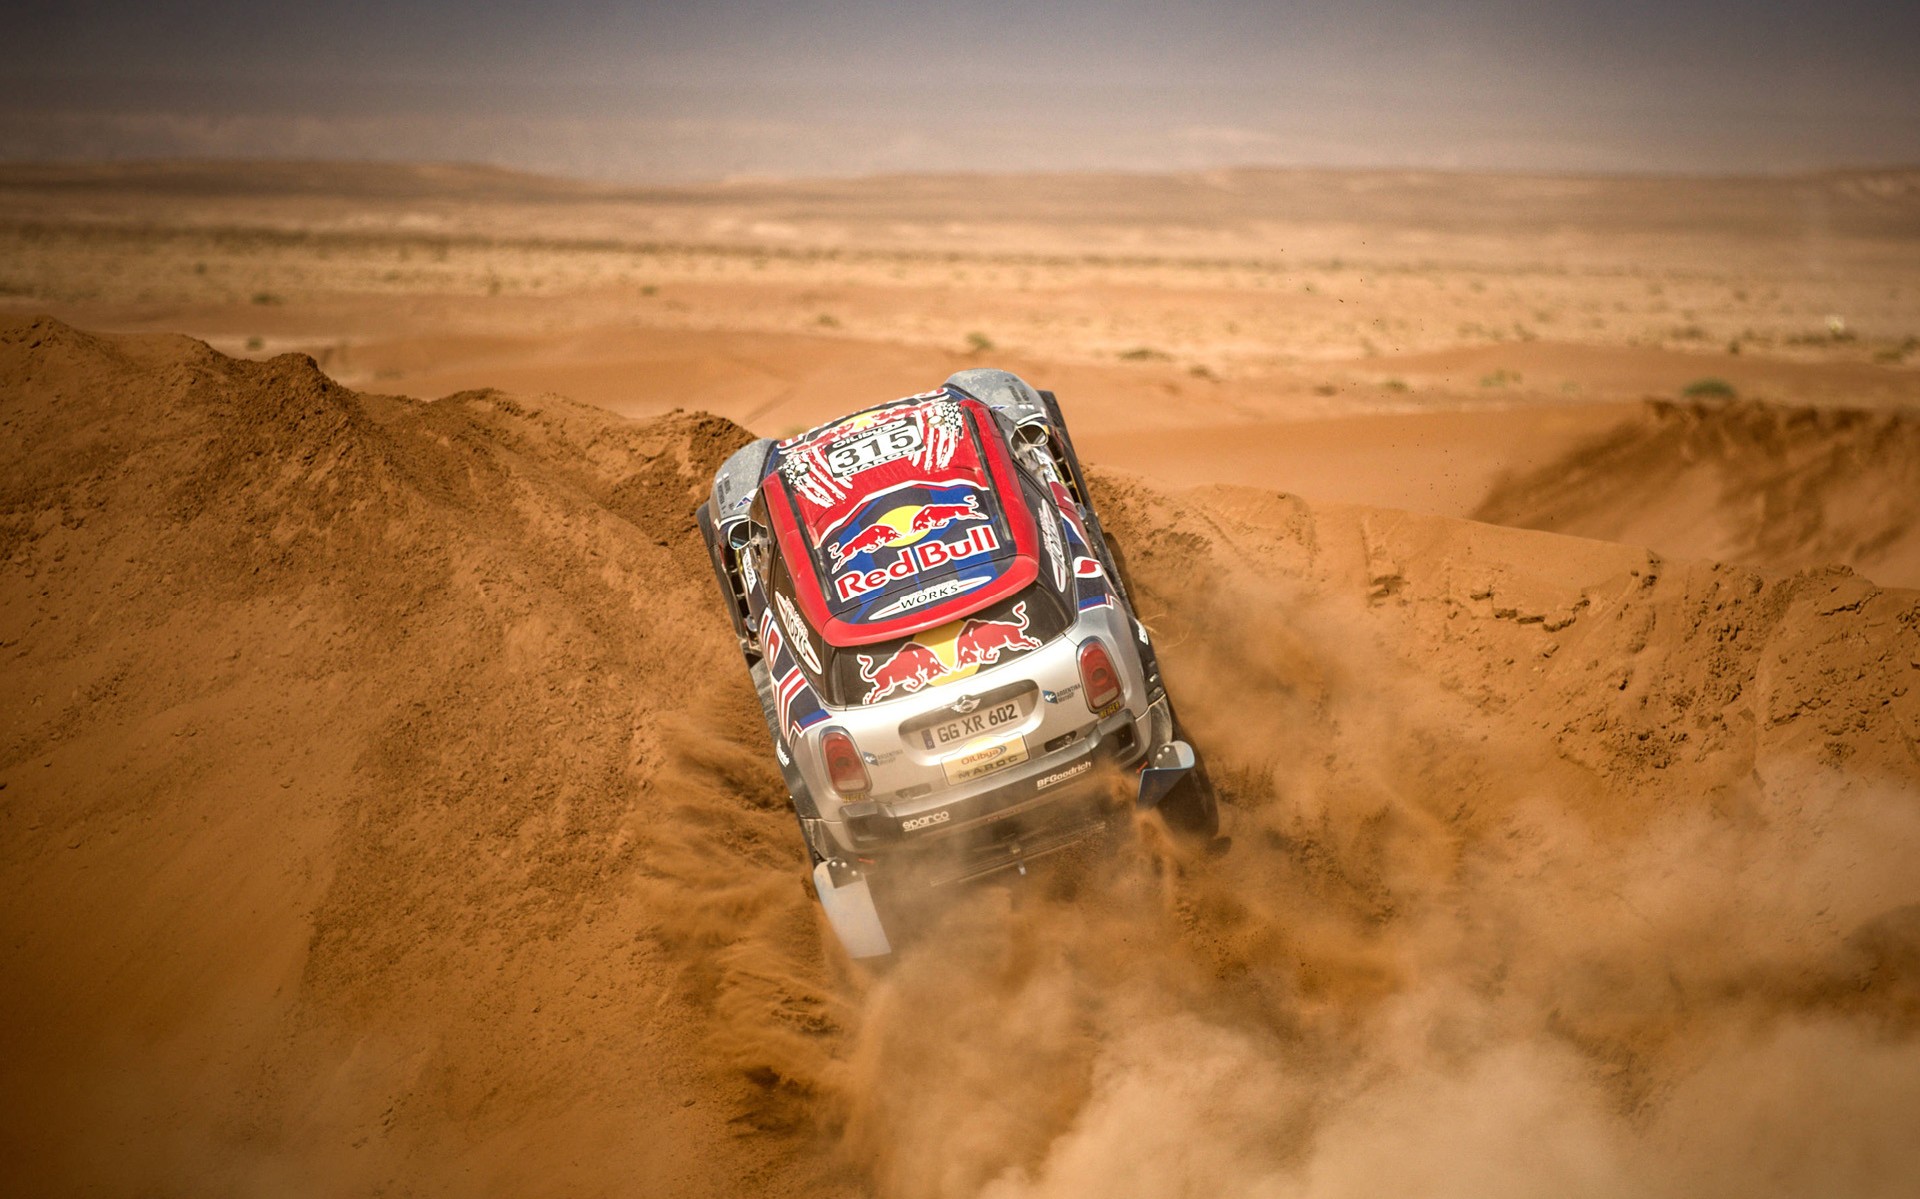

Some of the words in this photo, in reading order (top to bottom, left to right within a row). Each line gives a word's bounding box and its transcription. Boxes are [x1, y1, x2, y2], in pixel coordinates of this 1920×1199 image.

[835, 429, 915, 469] 315
[836, 548, 917, 600] Red
[917, 526, 998, 569] Bull
[901, 584, 958, 609] WORKS
[937, 723, 960, 743] GG
[961, 715, 985, 735] XR
[988, 703, 1018, 726] 602
[958, 755, 1018, 778] MAROC
[1036, 761, 1092, 789] BFGoodrich
[902, 811, 949, 831] sparco
